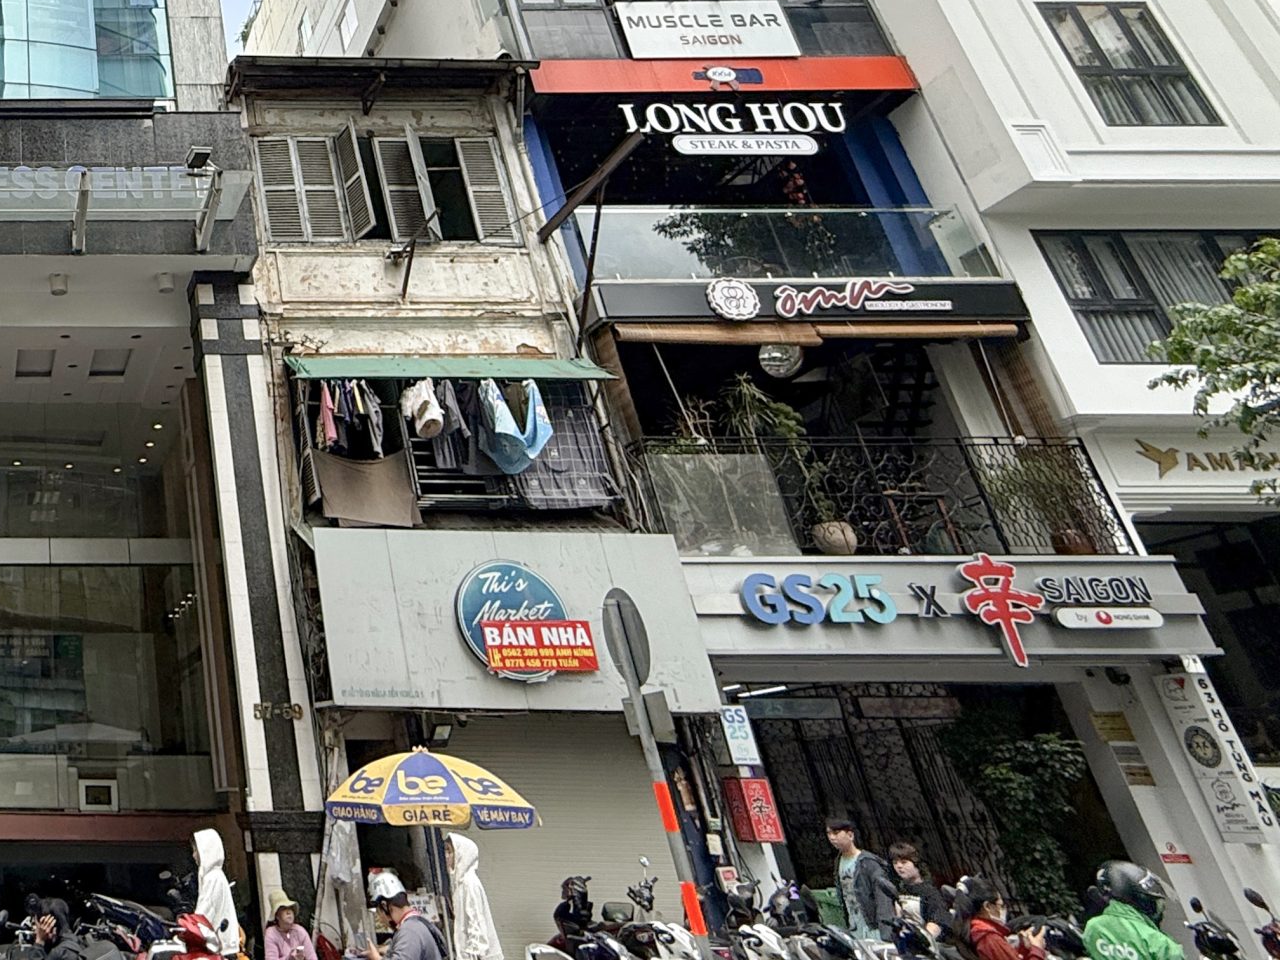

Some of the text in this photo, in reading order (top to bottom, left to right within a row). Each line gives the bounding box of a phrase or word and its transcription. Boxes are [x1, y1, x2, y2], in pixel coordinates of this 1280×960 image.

[626, 14, 782, 29] MUSCLE BAR
[680, 35, 743, 45] SAIGON
[618, 102, 846, 133] LONG HOU
[689, 140, 801, 150] STEAK & PASTA
[478, 570, 528, 594] Thi's
[1040, 576, 1153, 604] SAIGON
[740, 572, 898, 624] GS25
[472, 600, 553, 627] Market
[1075, 612, 1088, 622] by
[484, 620, 591, 647] BÁN NHÀ
[722, 708, 746, 724] GS
[728, 725, 749, 740] 25
[349, 769, 384, 793] be
[396, 770, 447, 795] be
[451, 769, 504, 797] be
[332, 806, 377, 820] GIAO HÀNG
[402, 804, 429, 822] GIÁ
[511, 811, 531, 823] BAY
[1096, 939, 1139, 960] Grab
